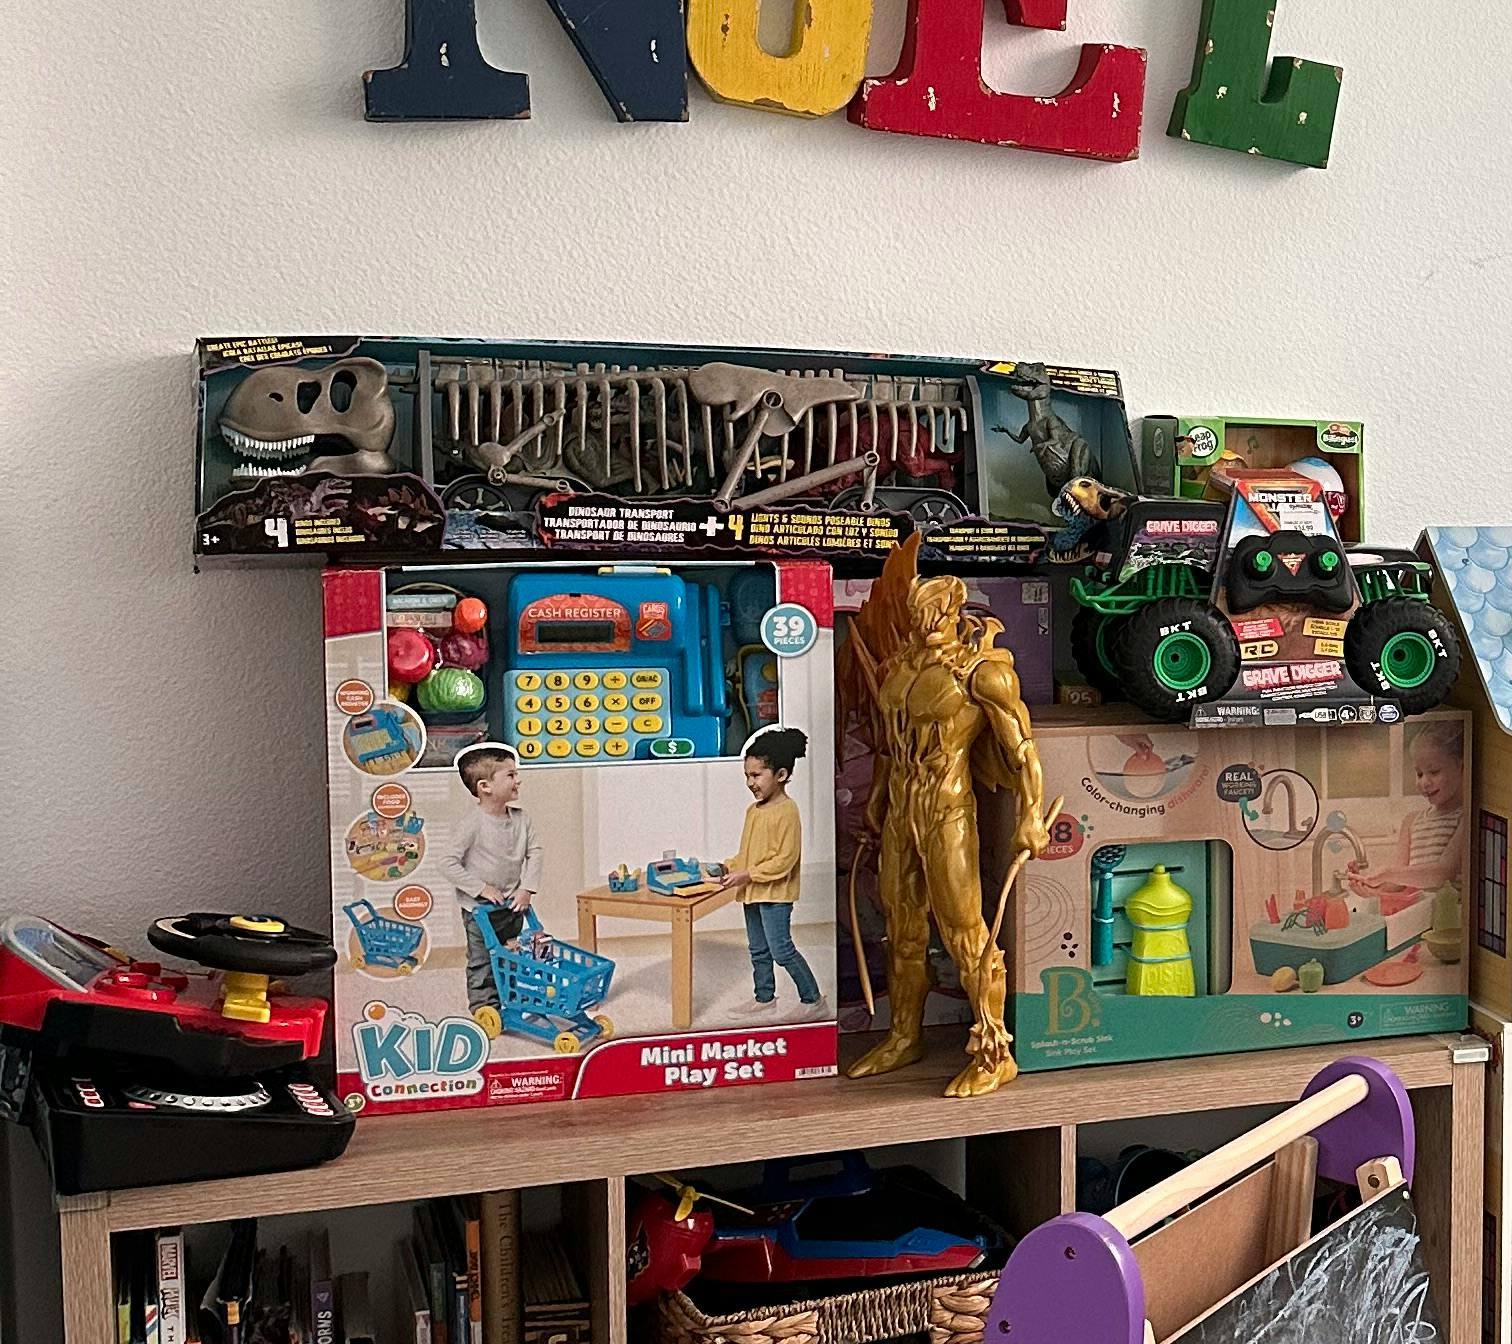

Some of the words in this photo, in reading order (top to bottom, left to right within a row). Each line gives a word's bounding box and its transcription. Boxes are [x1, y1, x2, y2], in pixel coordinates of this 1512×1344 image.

[1248, 493, 1312, 503] MONSTER
[568, 506, 616, 518] DINOSAUR
[619, 508, 675, 520] TRANSPORT
[751, 513, 780, 525] LIGHTS
[544, 517, 624, 529] TRANSPORTADOR
[627, 520, 639, 530] DE
[641, 520, 697, 532] DINOSAURIO
[728, 515, 744, 541] 4
[1146, 520, 1180, 534] GRAVE
[1182, 520, 1218, 534] DIGGER
[202, 533, 220, 546] 3+
[264, 517, 289, 548] 4
[555, 529, 610, 540] TRANSPORT
[613, 530, 625, 541] DE
[627, 531, 685, 543] DINOSAURES
[528, 607, 561, 620] CASH
[563, 606, 621, 620] REGISTER
[772, 616, 805, 638] 39
[1159, 621, 1192, 637] BKT
[774, 635, 805, 646] PIECES
[1427, 628, 1448, 659] BKT
[1244, 642, 1274, 656] RC
[525, 675, 533, 687] 7
[554, 675, 562, 687] 8
[582, 675, 591, 687] 9
[1242, 665, 1290, 688] GRAVE
[1291, 661, 1343, 685] DIGGER
[1370, 661, 1391, 691] BKT
[1176, 685, 1207, 703] BKT
[524, 697, 534, 709] 4
[554, 697, 563, 709] 5
[583, 696, 592, 709] 6
[639, 697, 656, 707] OFF
[1217, 706, 1260, 716] WARNING:
[1314, 710, 1327, 719] USB
[1340, 710, 1355, 719] 4+
[555, 719, 564, 731] 2
[584, 719, 592, 731] 3
[526, 742, 535, 754] 0
[1225, 772, 1253, 781] REAL
[1081, 777, 1165, 818] Color-changing
[1150, 968, 1183, 982] DISH
[359, 1022, 484, 1080] KID
[641, 1044, 694, 1066] Mini
[701, 1037, 787, 1061] Market
[665, 1066, 717, 1086] Play
[724, 1061, 764, 1080] Set
[499, 1203, 513, 1227] The
[161, 1244, 178, 1279] MARVEL
[499, 1235, 514, 1308] Children's
